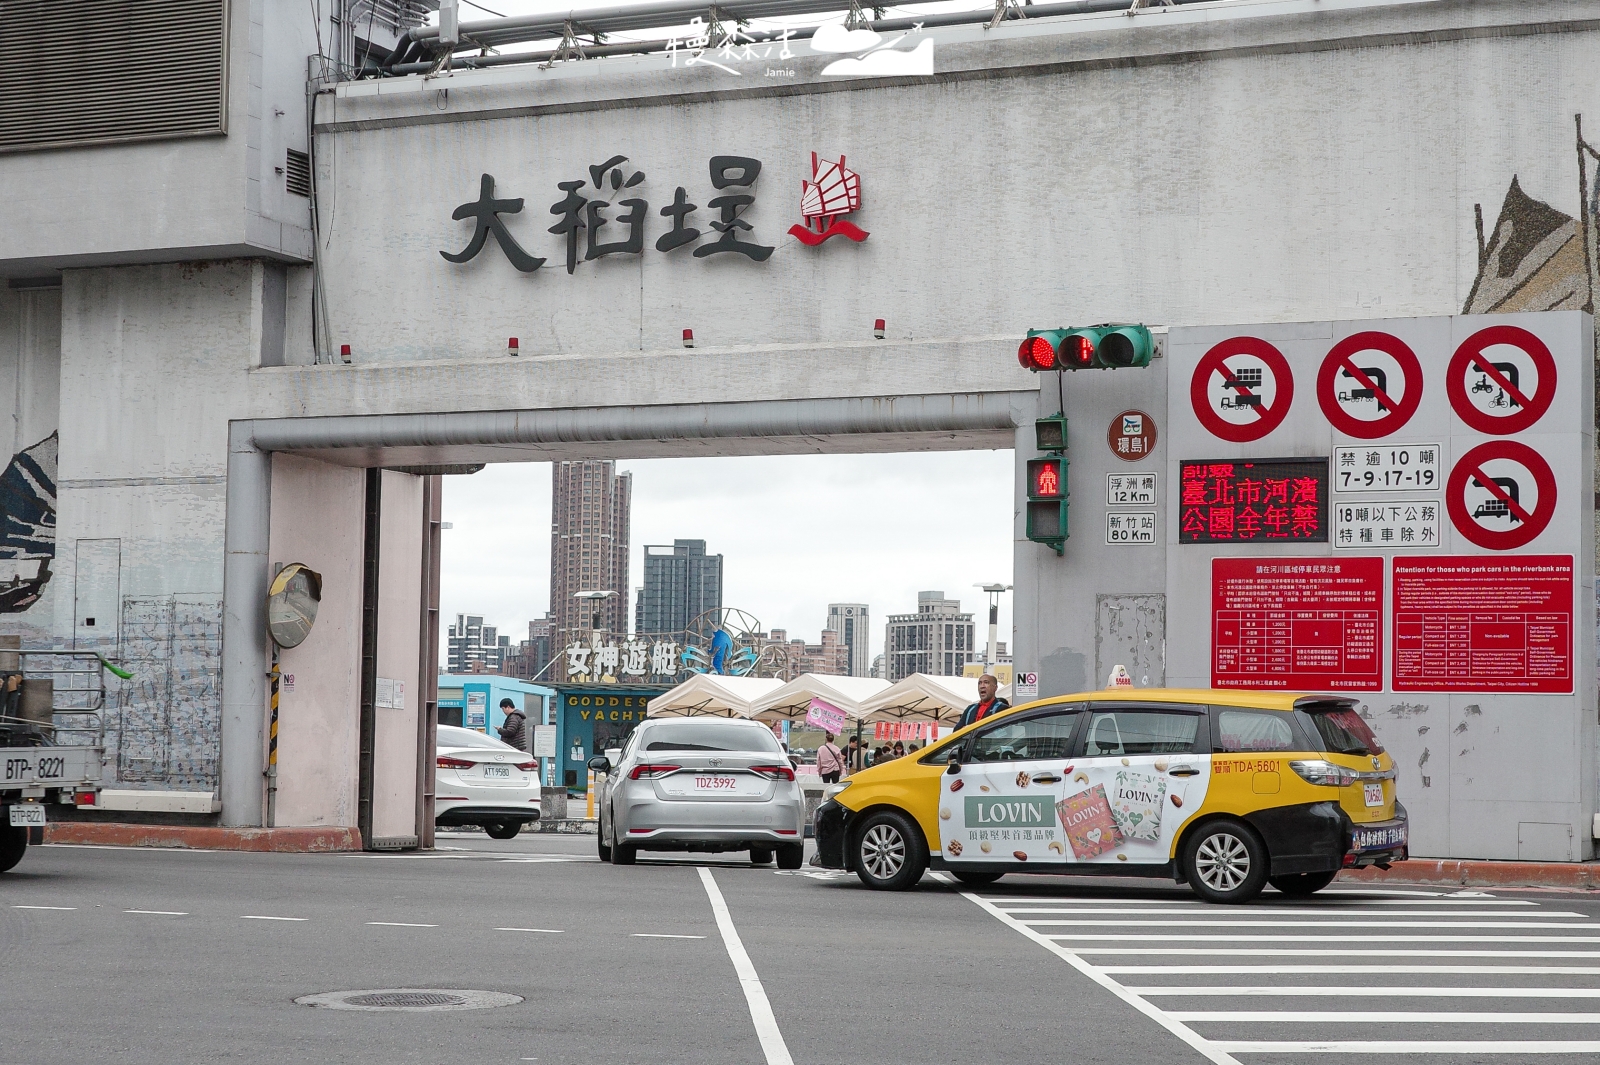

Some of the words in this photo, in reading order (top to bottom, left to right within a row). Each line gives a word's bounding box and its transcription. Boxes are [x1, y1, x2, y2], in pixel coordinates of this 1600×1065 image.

[439, 154, 776, 275] 大稻埕
[1115, 492, 1127, 501] 12
[1130, 492, 1149, 501] Km
[1110, 516, 1153, 529] 新竹站
[1182, 504, 1318, 533] 公園全年禁
[1111, 530, 1128, 540] 80
[1132, 530, 1150, 540] Km
[1340, 527, 1435, 543] 特種車除外
[1471, 566, 1486, 574] park
[567, 640, 678, 676] 女神遊艇
[38, 757, 65, 778] 8221
[1233, 760, 1280, 772] TDA-5601
[1119, 788, 1153, 803] LOVIN
[977, 802, 1042, 823] LOVIN
[1066, 804, 1100, 827] LOVIN
[969, 829, 1055, 841] 頂級堅果首選品牌
